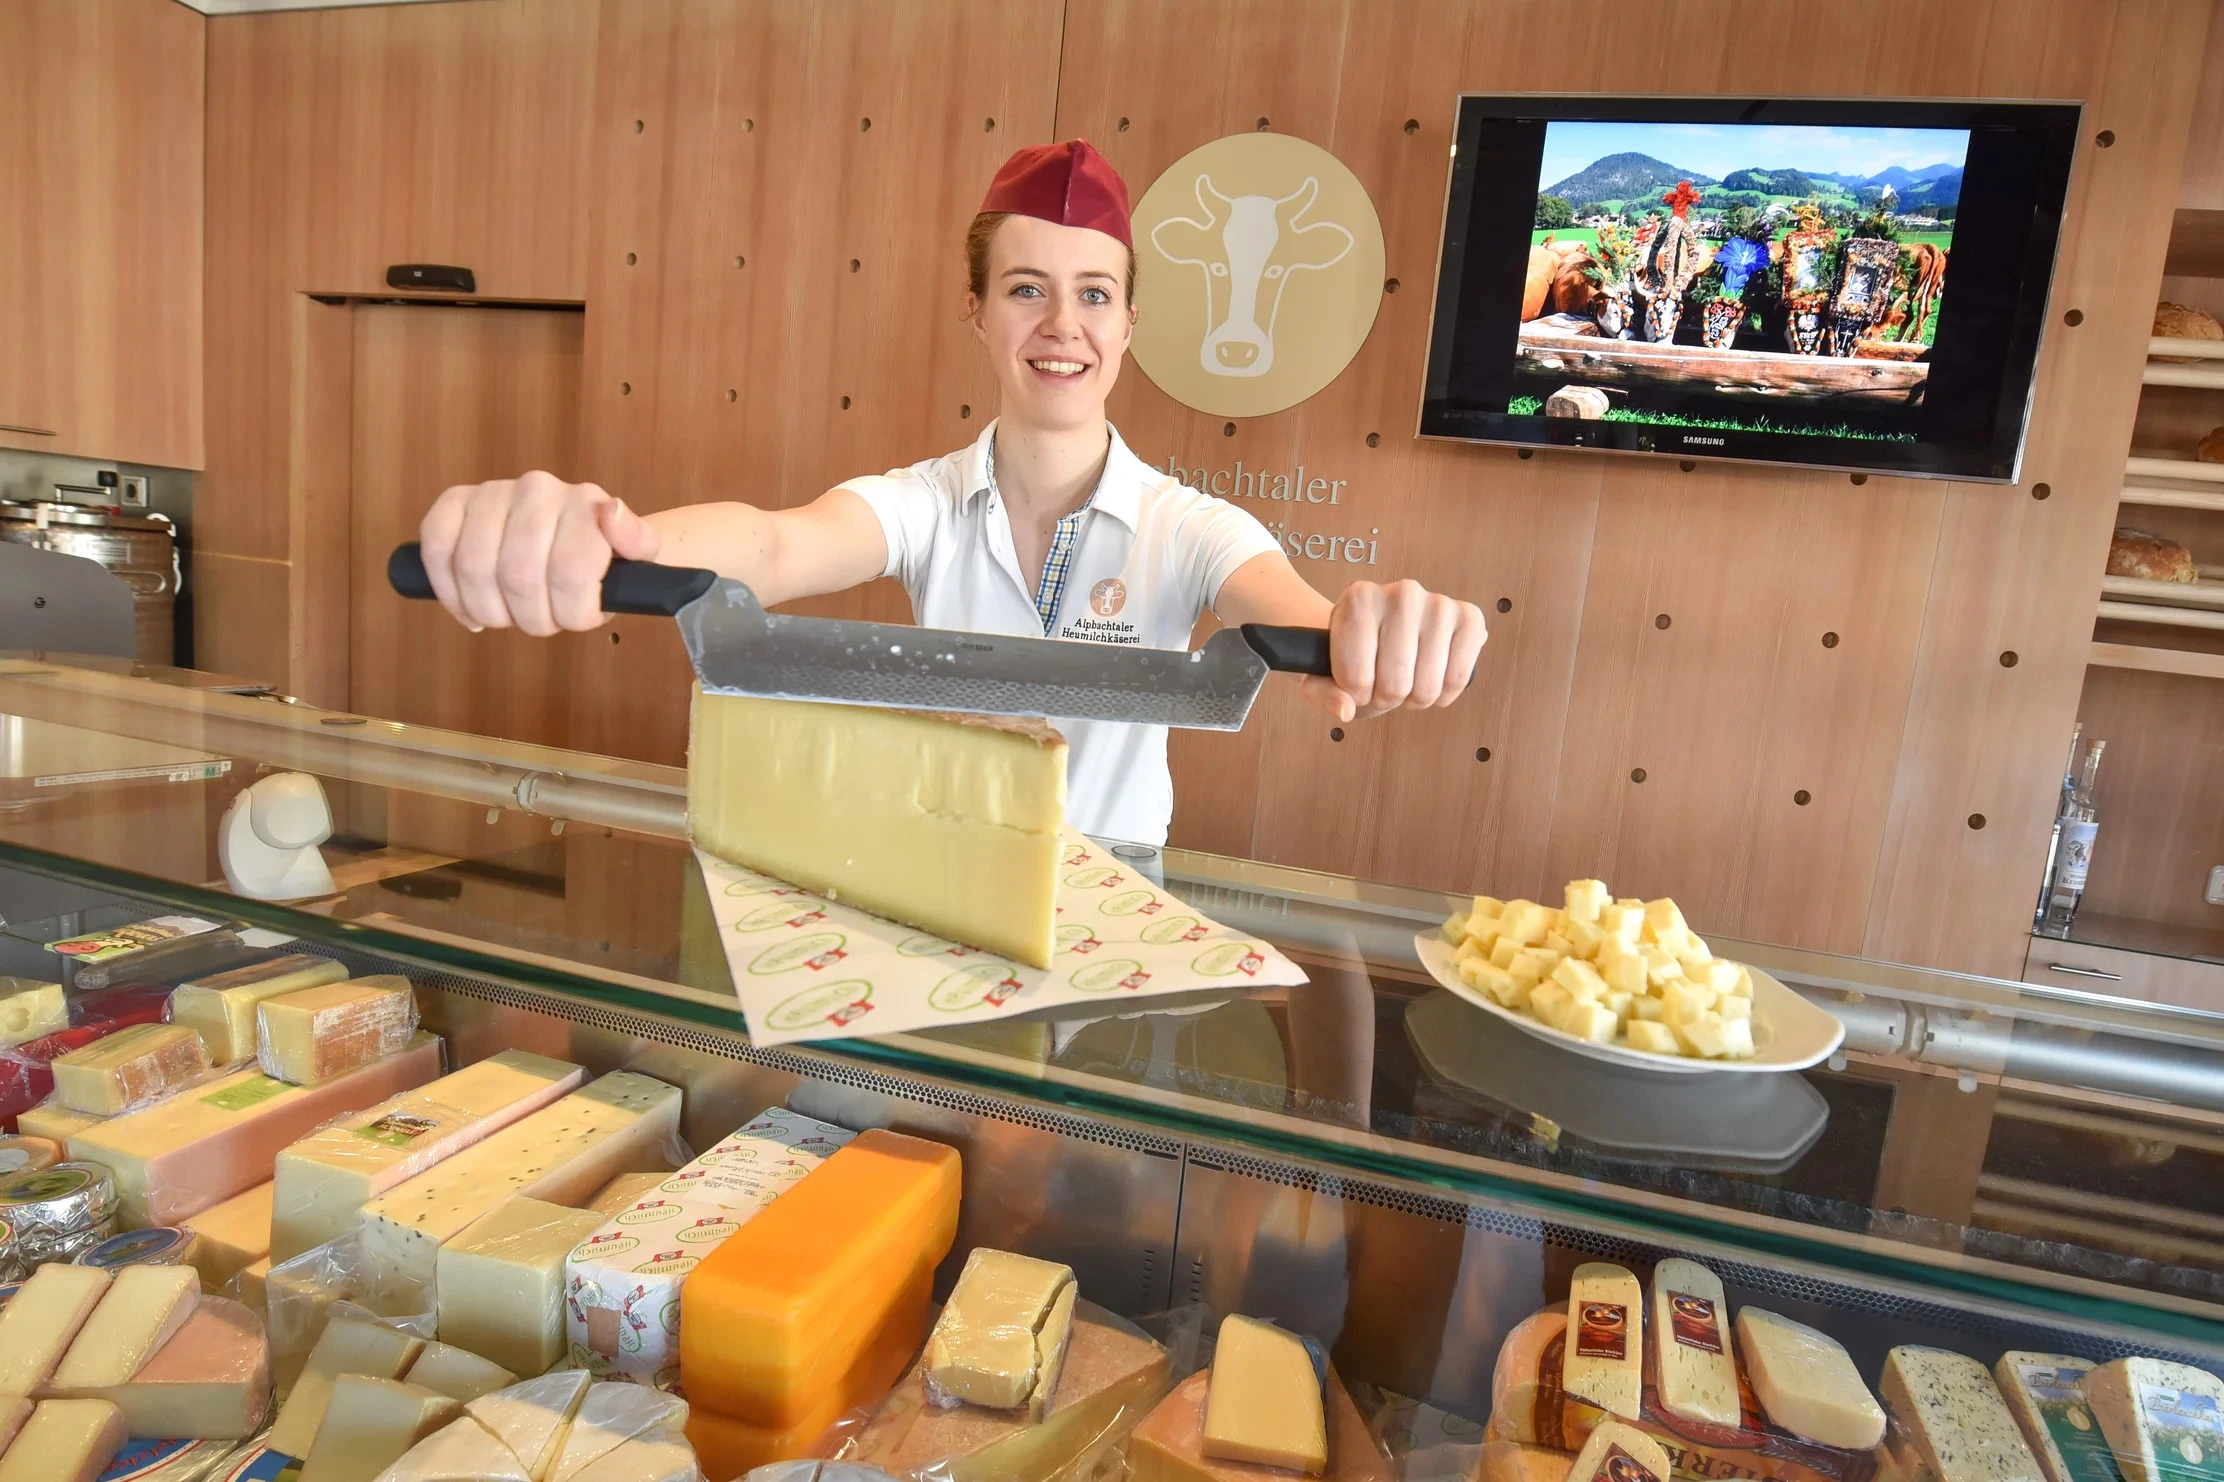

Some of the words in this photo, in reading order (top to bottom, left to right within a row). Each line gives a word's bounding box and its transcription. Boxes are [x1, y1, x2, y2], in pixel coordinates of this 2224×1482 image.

[1683, 435, 1725, 446] SAMSUNG
[1150, 455, 1348, 505] bachtaler
[1074, 618, 1135, 632] Alpbachtaler
[1062, 627, 1141, 644] Heumilchkäserei
[578, 1240, 632, 1256] Heumilch
[1668, 1440, 1784, 1482] IERK
